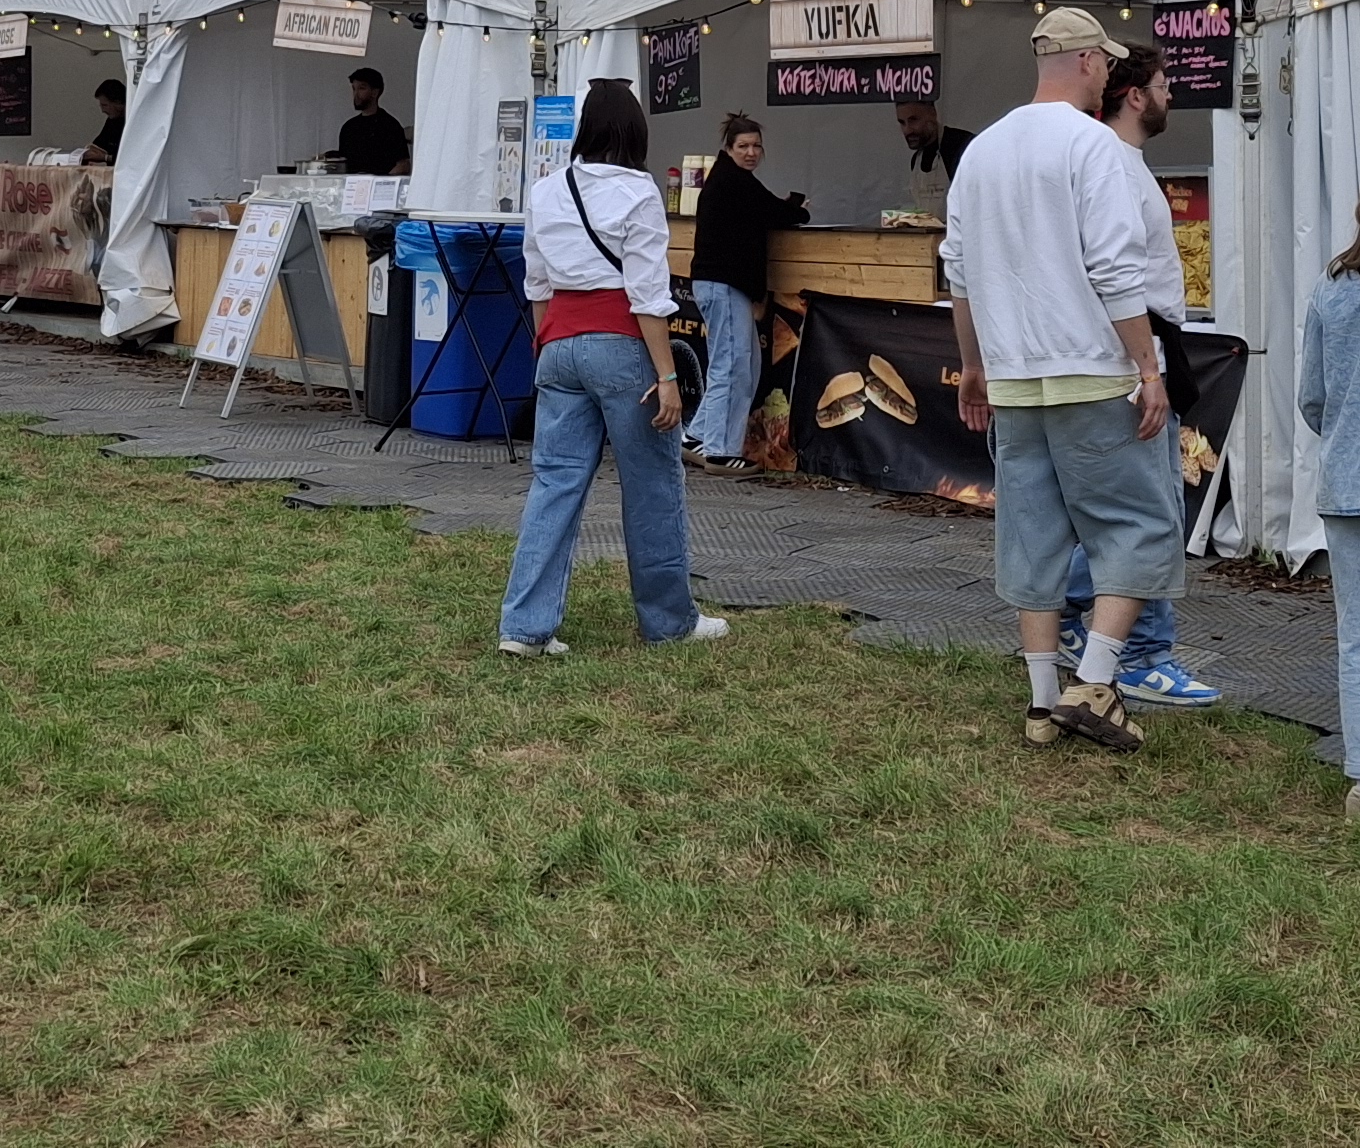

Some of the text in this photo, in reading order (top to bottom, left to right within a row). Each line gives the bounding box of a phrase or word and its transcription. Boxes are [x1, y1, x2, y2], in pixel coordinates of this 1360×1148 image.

[283, 12, 360, 40] AFRICAN FOOD
[804, 3, 880, 41] YUFKA
[1169, 7, 1231, 39] NACHOS
[876, 62, 934, 101] NACHOS
[1, 169, 53, 216] Rose
